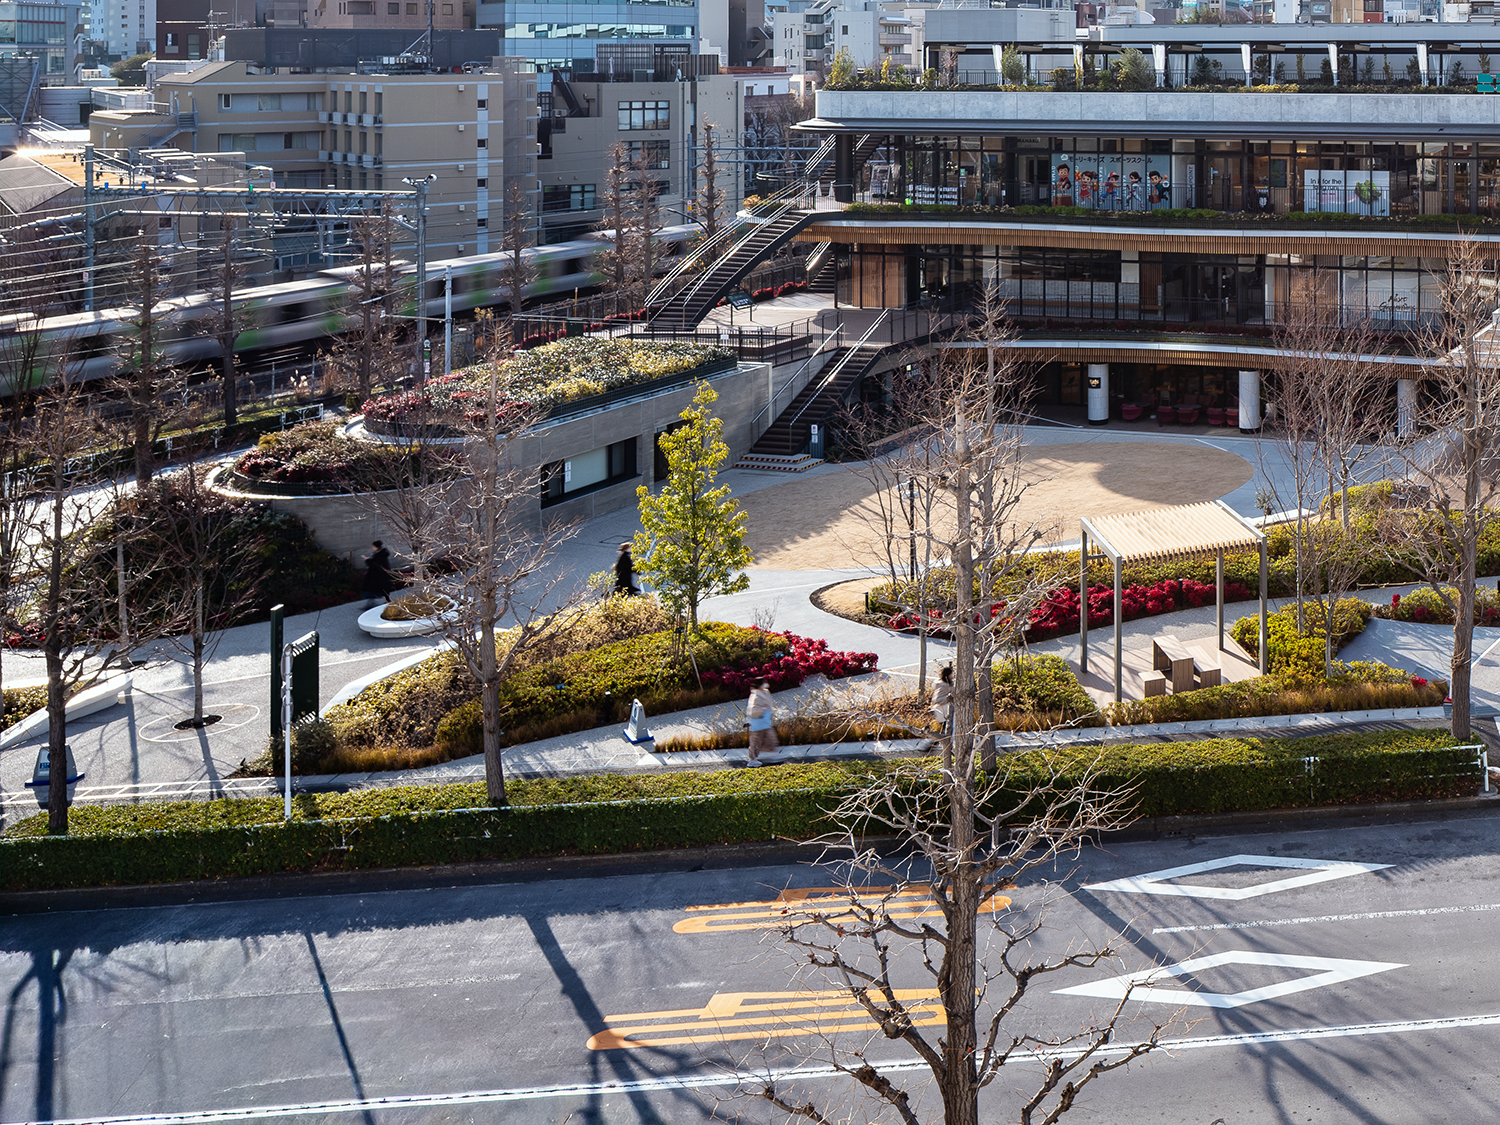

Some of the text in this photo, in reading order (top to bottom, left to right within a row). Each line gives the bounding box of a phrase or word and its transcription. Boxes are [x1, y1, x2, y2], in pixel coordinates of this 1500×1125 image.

[1109, 156, 1153, 164] スポーツスクール
